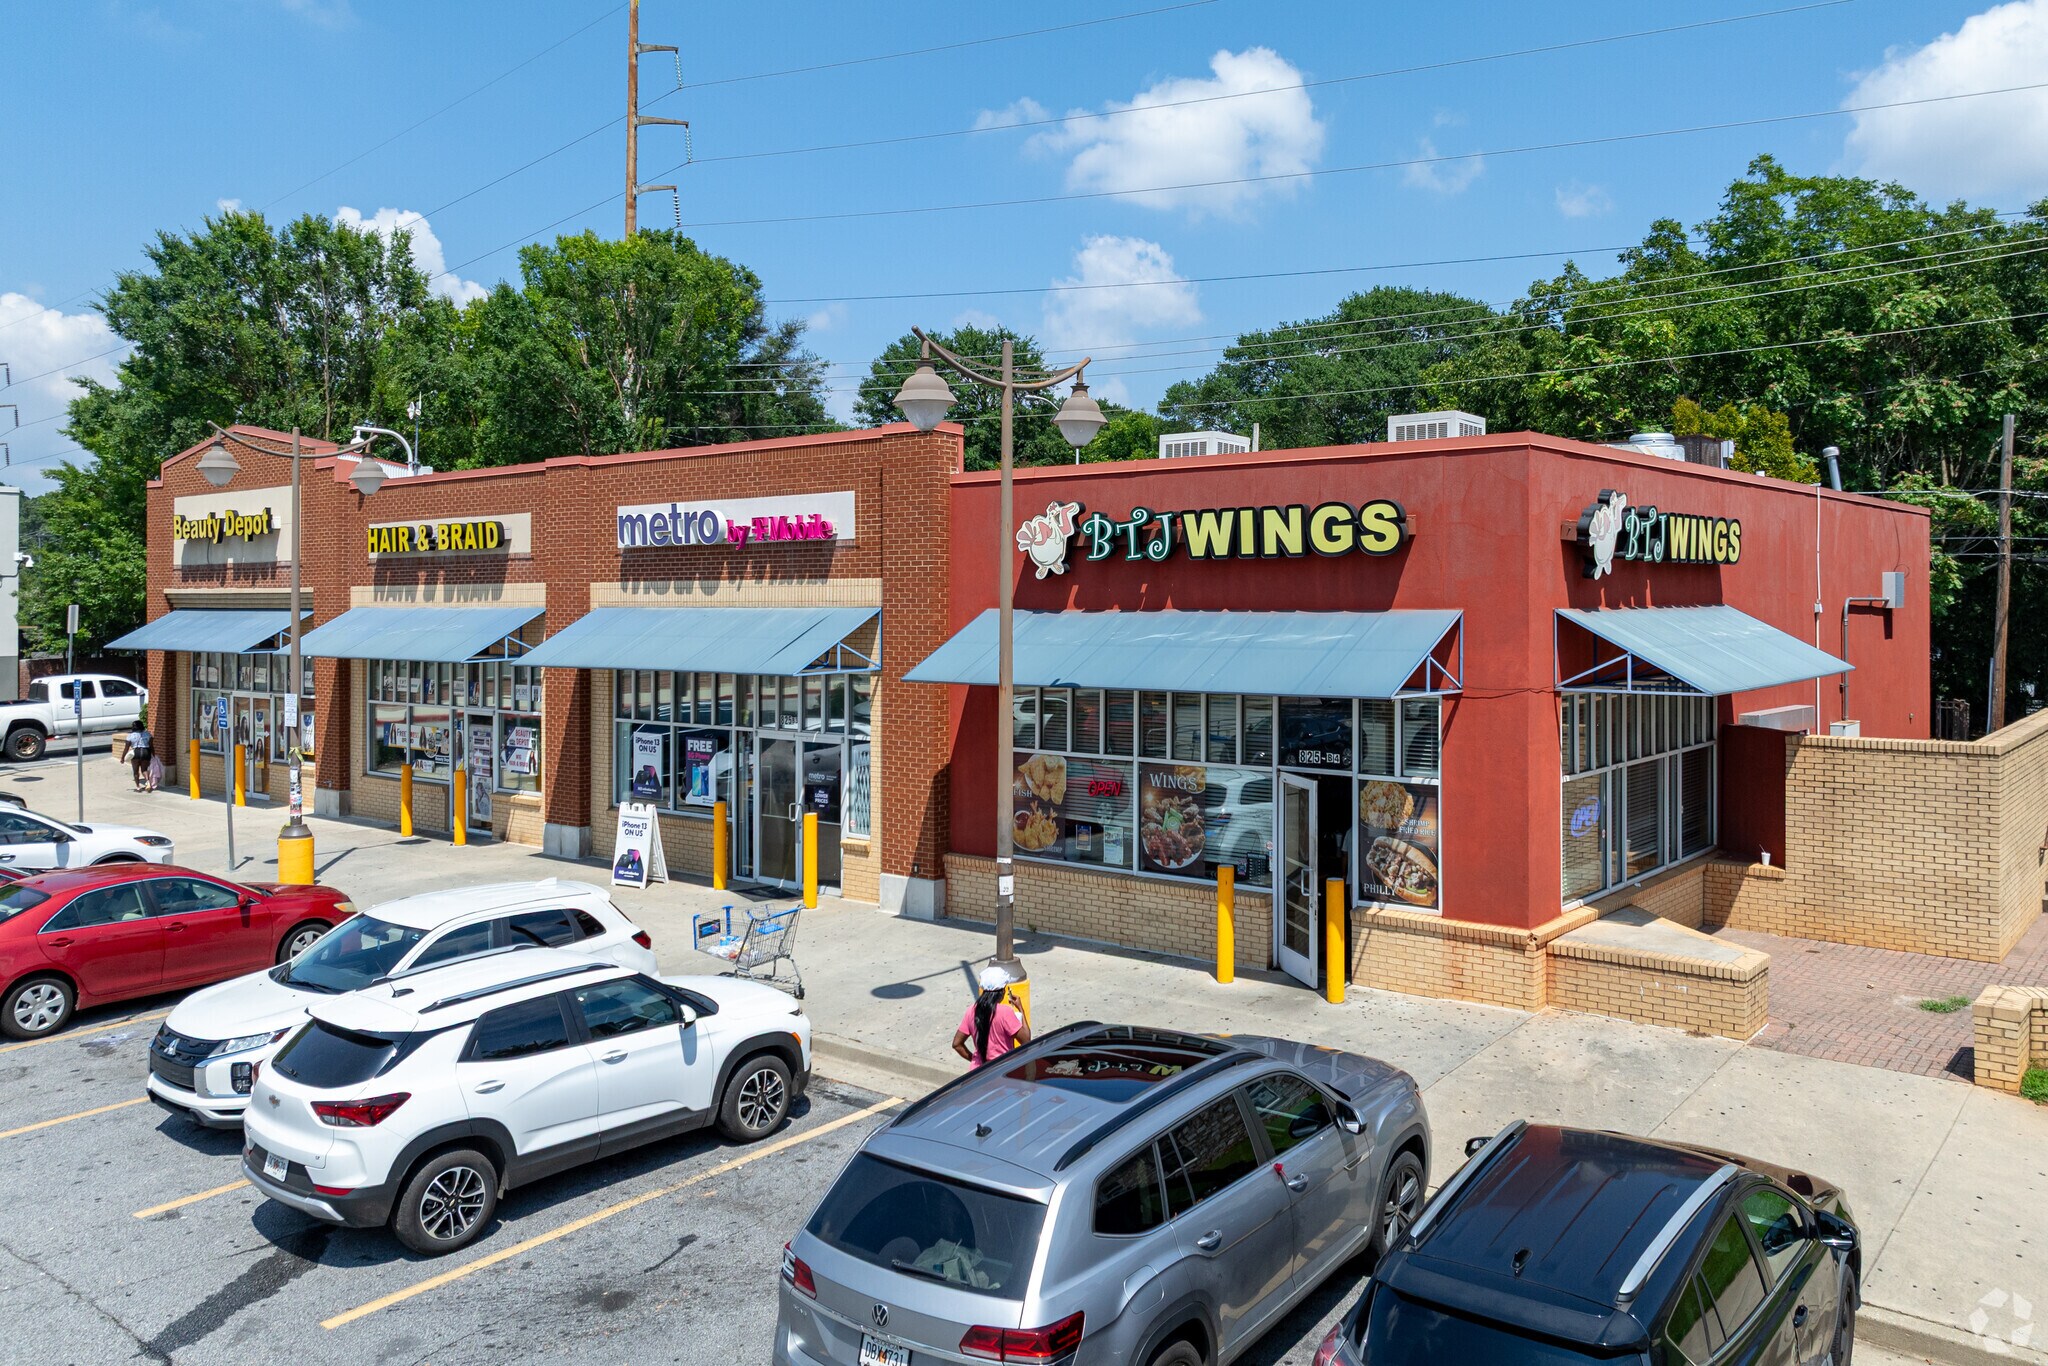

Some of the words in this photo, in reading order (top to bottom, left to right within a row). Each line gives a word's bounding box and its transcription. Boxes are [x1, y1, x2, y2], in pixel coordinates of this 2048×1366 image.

[173, 514, 221, 545] Beauty
[225, 507, 271, 542] Depot
[618, 503, 719, 546] metro
[727, 519, 750, 550] by
[1083, 508, 1173, 562] BTJ
[1181, 501, 1402, 560] WINGS
[367, 526, 411, 553] HAIR
[417, 524, 430, 552] &
[437, 521, 499, 551] BRAID
[1625, 506, 1667, 563] BTJ
[1669, 515, 1741, 562] WINGS
[635, 737, 653, 745] iPhone
[654, 738, 660, 746] 13
[687, 739, 713, 752] FREE
[808, 772, 825, 780] metro
[1149, 772, 1197, 791] WINGS
[1013, 788, 1033, 798] FISH
[1087, 780, 1121, 797] OPEN
[621, 820, 640, 829] iPhone
[641, 822, 647, 830] 13
[1399, 826, 1419, 835] FRIED
[1363, 883, 1396, 896] PHILLY
